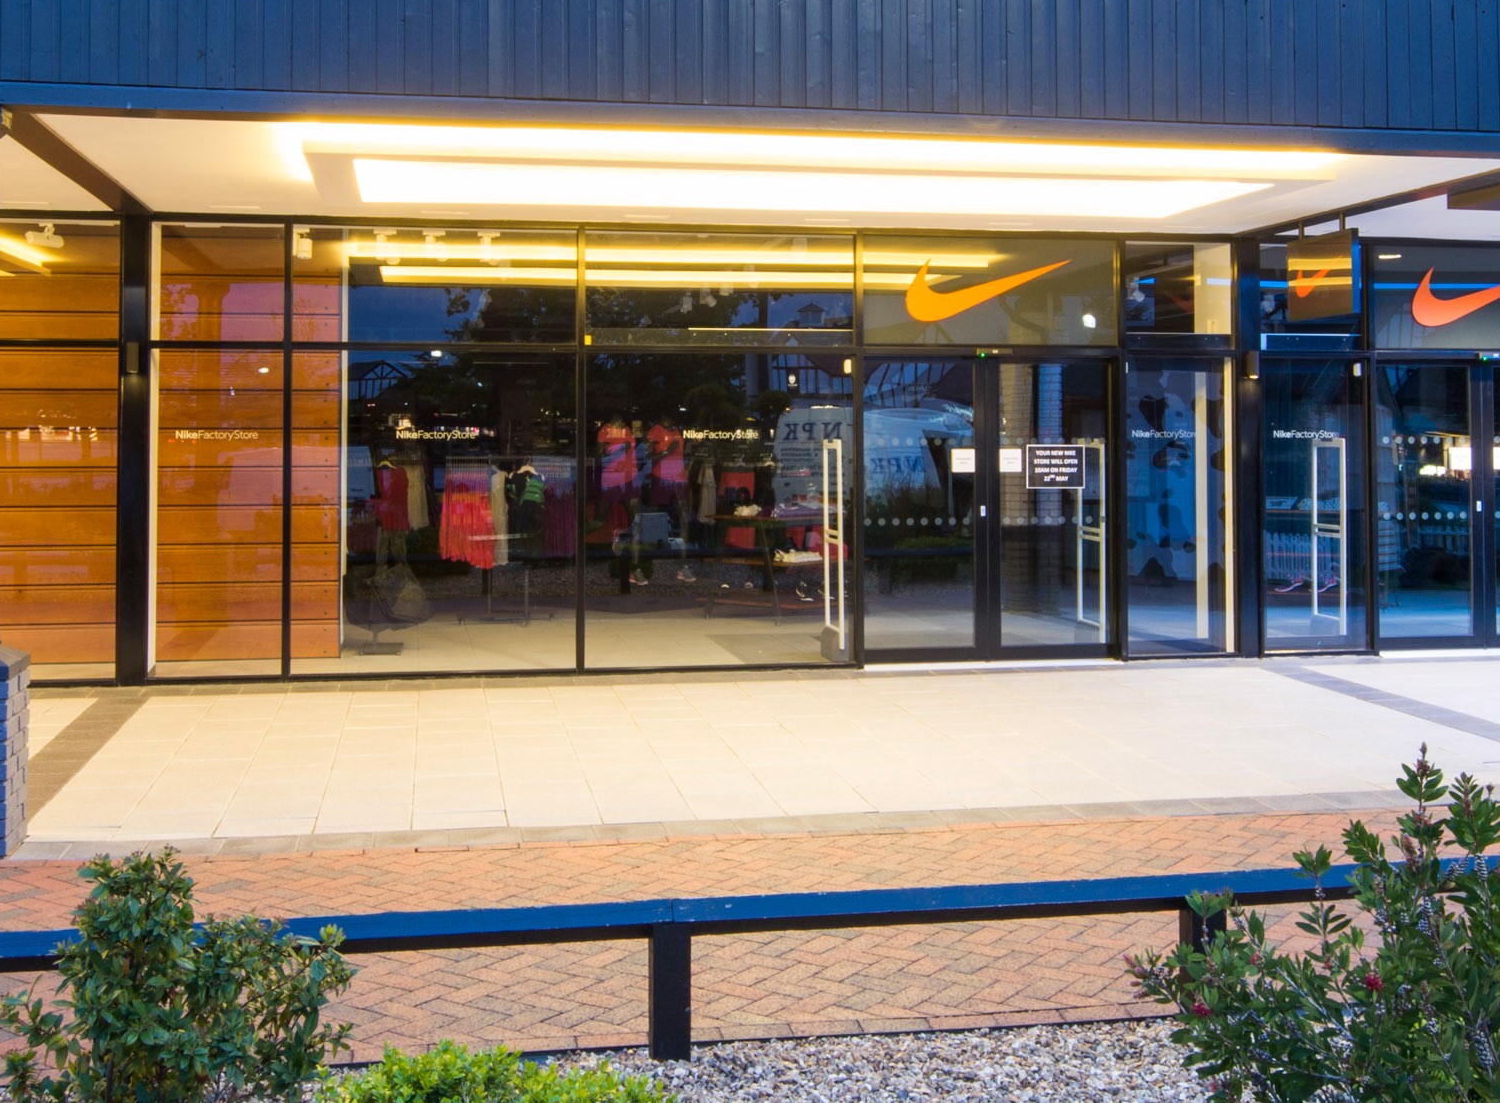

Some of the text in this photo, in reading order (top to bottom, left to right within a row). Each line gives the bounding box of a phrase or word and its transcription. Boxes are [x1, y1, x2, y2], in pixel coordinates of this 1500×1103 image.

[175, 430, 259, 441] NikeFactoryStore
[396, 430, 476, 441] NikeFactoryStore
[683, 429, 759, 441] NikeFactoryStore
